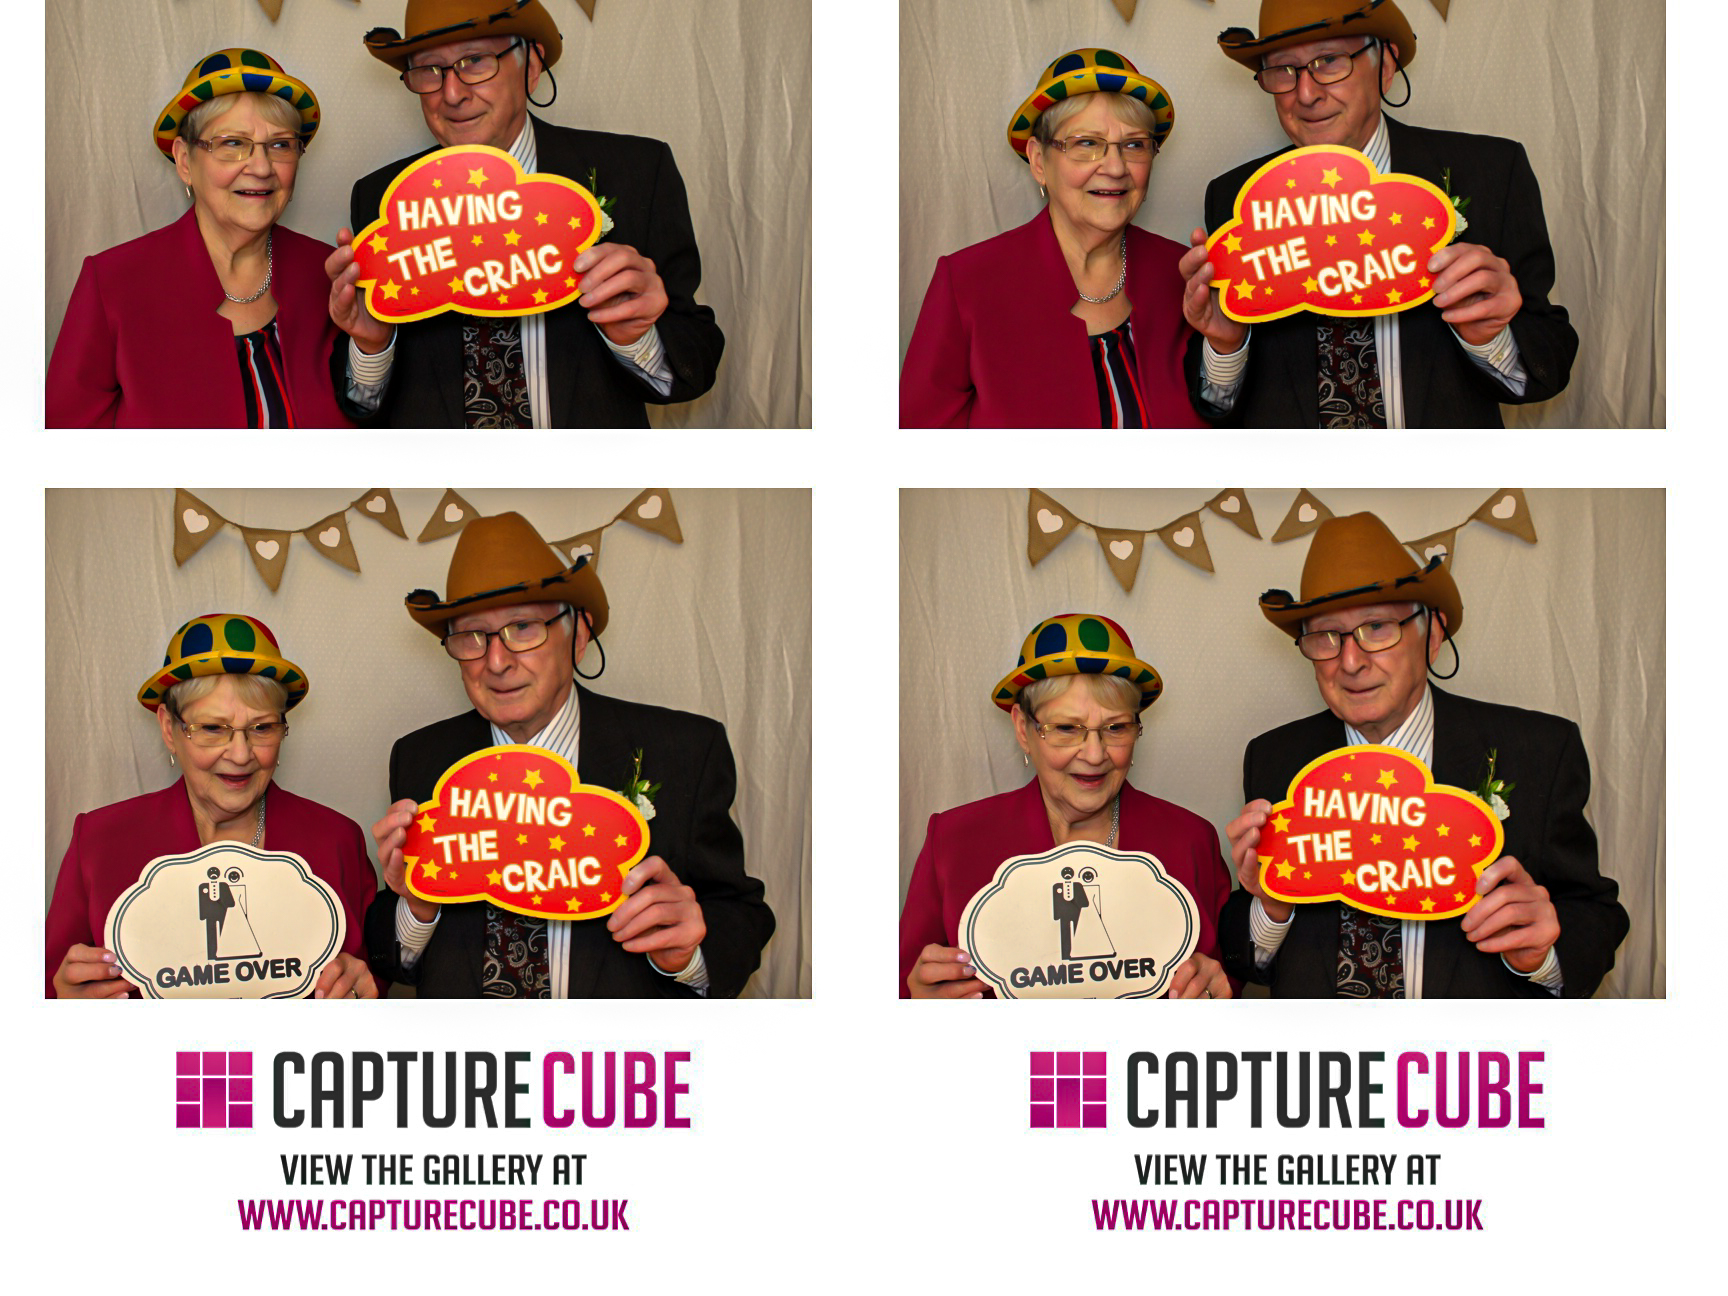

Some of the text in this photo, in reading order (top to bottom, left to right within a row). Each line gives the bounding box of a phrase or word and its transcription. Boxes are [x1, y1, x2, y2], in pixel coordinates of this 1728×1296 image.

[396, 189, 524, 232] HAVING
[1250, 189, 1378, 232] HAVING
[386, 235, 458, 281] THE
[462, 243, 564, 297] CRAIC
[1240, 235, 1312, 281] THE
[1316, 243, 1418, 297] CRAIC
[449, 786, 573, 828] HAVING
[1303, 786, 1427, 828] HAVING
[432, 829, 500, 865] THE
[1286, 829, 1354, 865] THE
[501, 856, 602, 893] CRAIC
[1355, 856, 1456, 893] CRAIC
[156, 957, 303, 989] GAME OVER
[1010, 957, 1157, 989] GAME OVER
